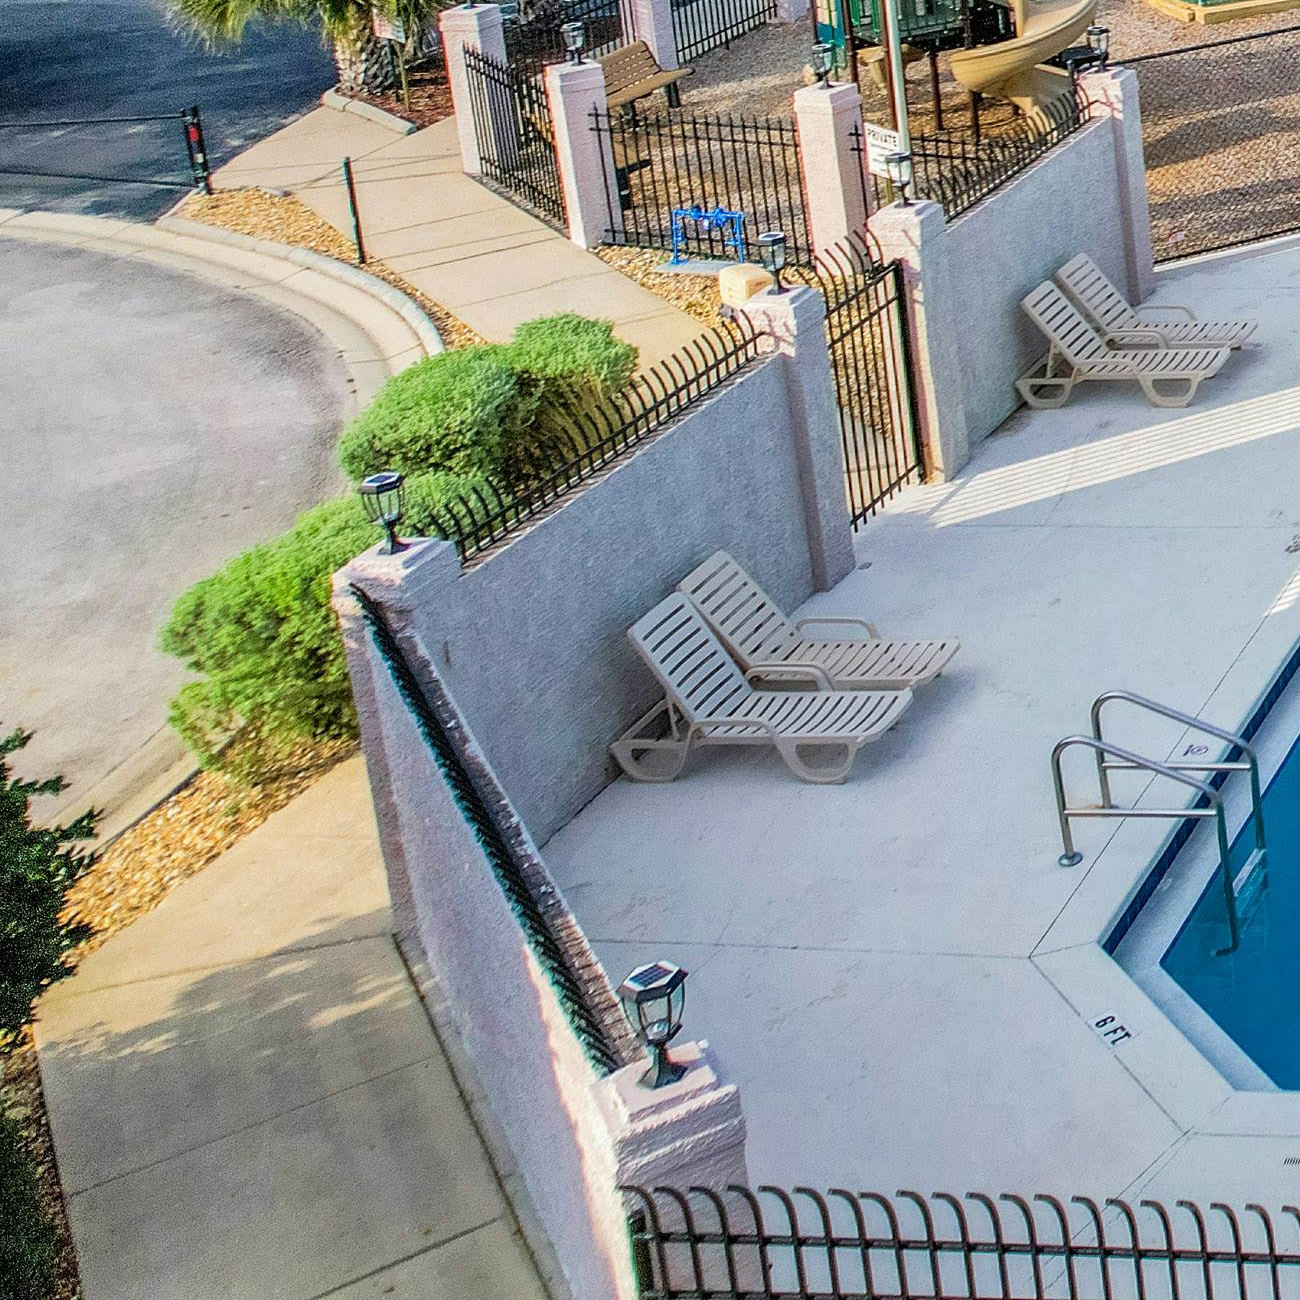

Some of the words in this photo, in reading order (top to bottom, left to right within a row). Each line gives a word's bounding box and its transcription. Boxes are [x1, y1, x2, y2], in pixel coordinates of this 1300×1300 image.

[867, 128, 897, 147] PRIVATE
[1095, 1015, 1115, 1028] 6
[1103, 1025, 1132, 1046] FT
